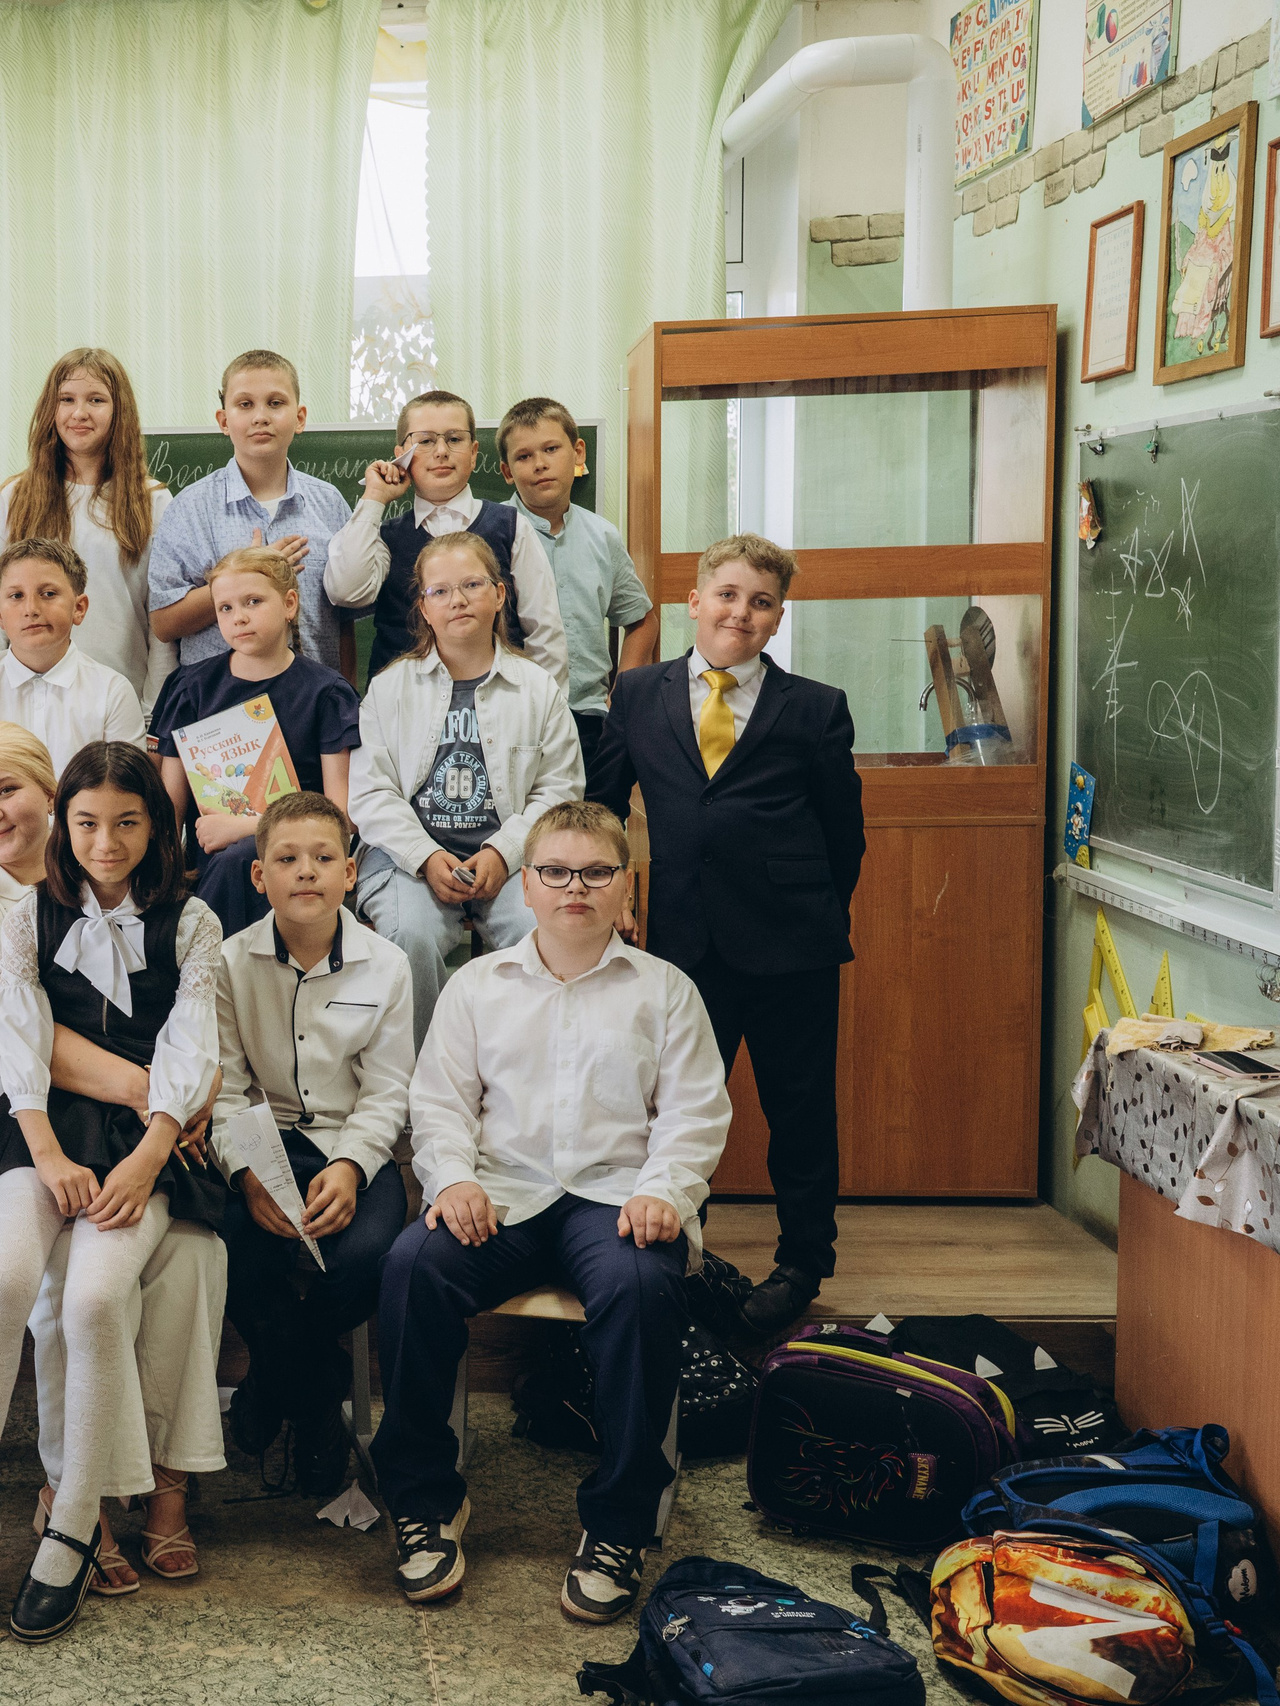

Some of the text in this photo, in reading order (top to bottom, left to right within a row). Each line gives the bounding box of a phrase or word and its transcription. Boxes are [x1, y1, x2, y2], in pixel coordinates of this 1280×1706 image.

[188, 733, 242, 761] Русский
[264, 756, 298, 805] 4
[434, 753, 486, 812] DREAM TEAM COLLEGE LEAGUE
